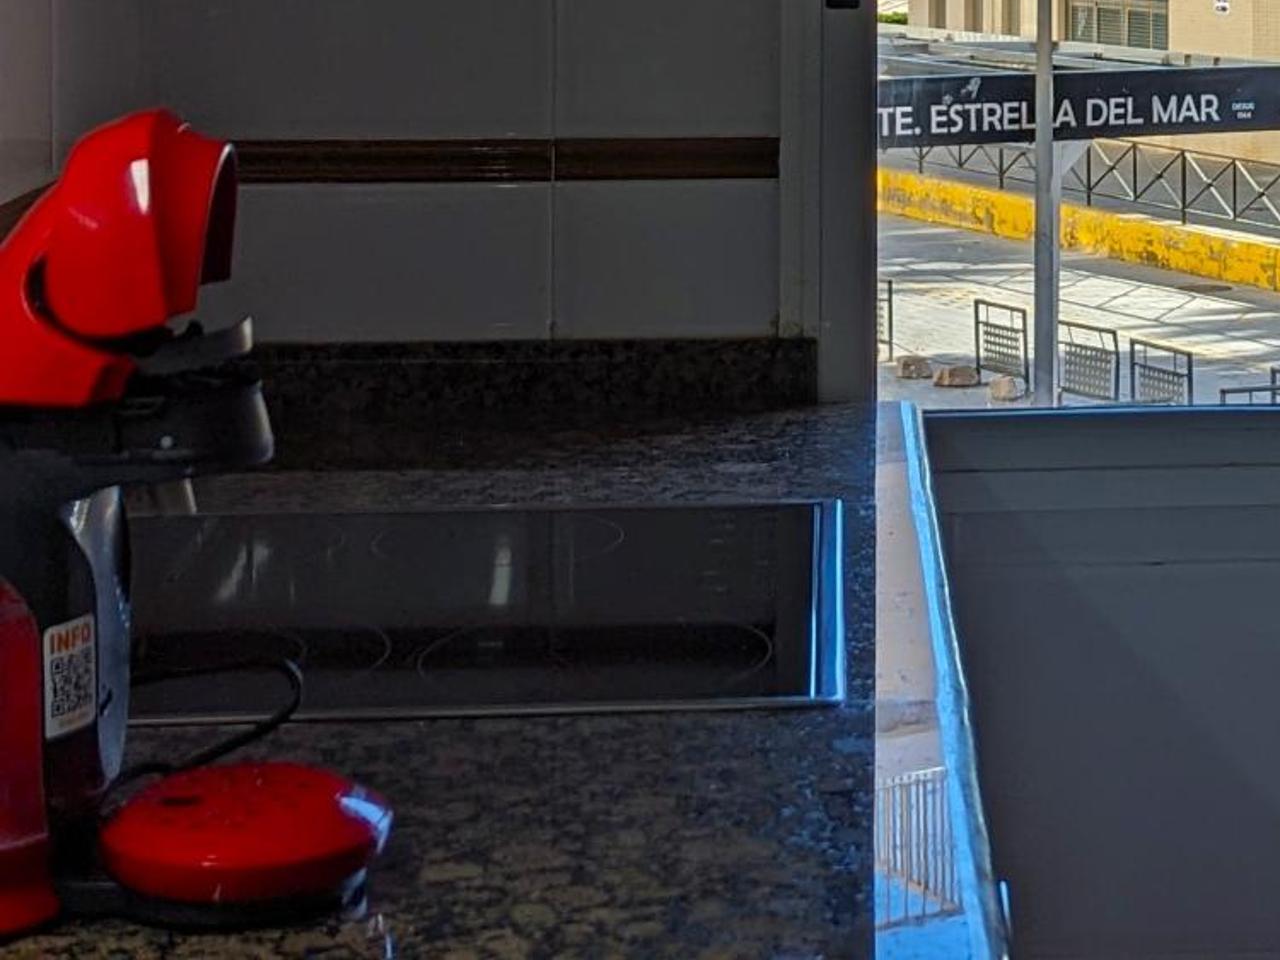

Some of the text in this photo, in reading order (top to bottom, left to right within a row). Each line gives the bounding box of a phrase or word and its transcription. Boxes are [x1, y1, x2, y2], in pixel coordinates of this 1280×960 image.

[930, 99, 1077, 134] ESTRELA
[1086, 97, 1144, 127] DEL
[1152, 94, 1221, 124] MAR
[50, 623, 91, 655] INFO
